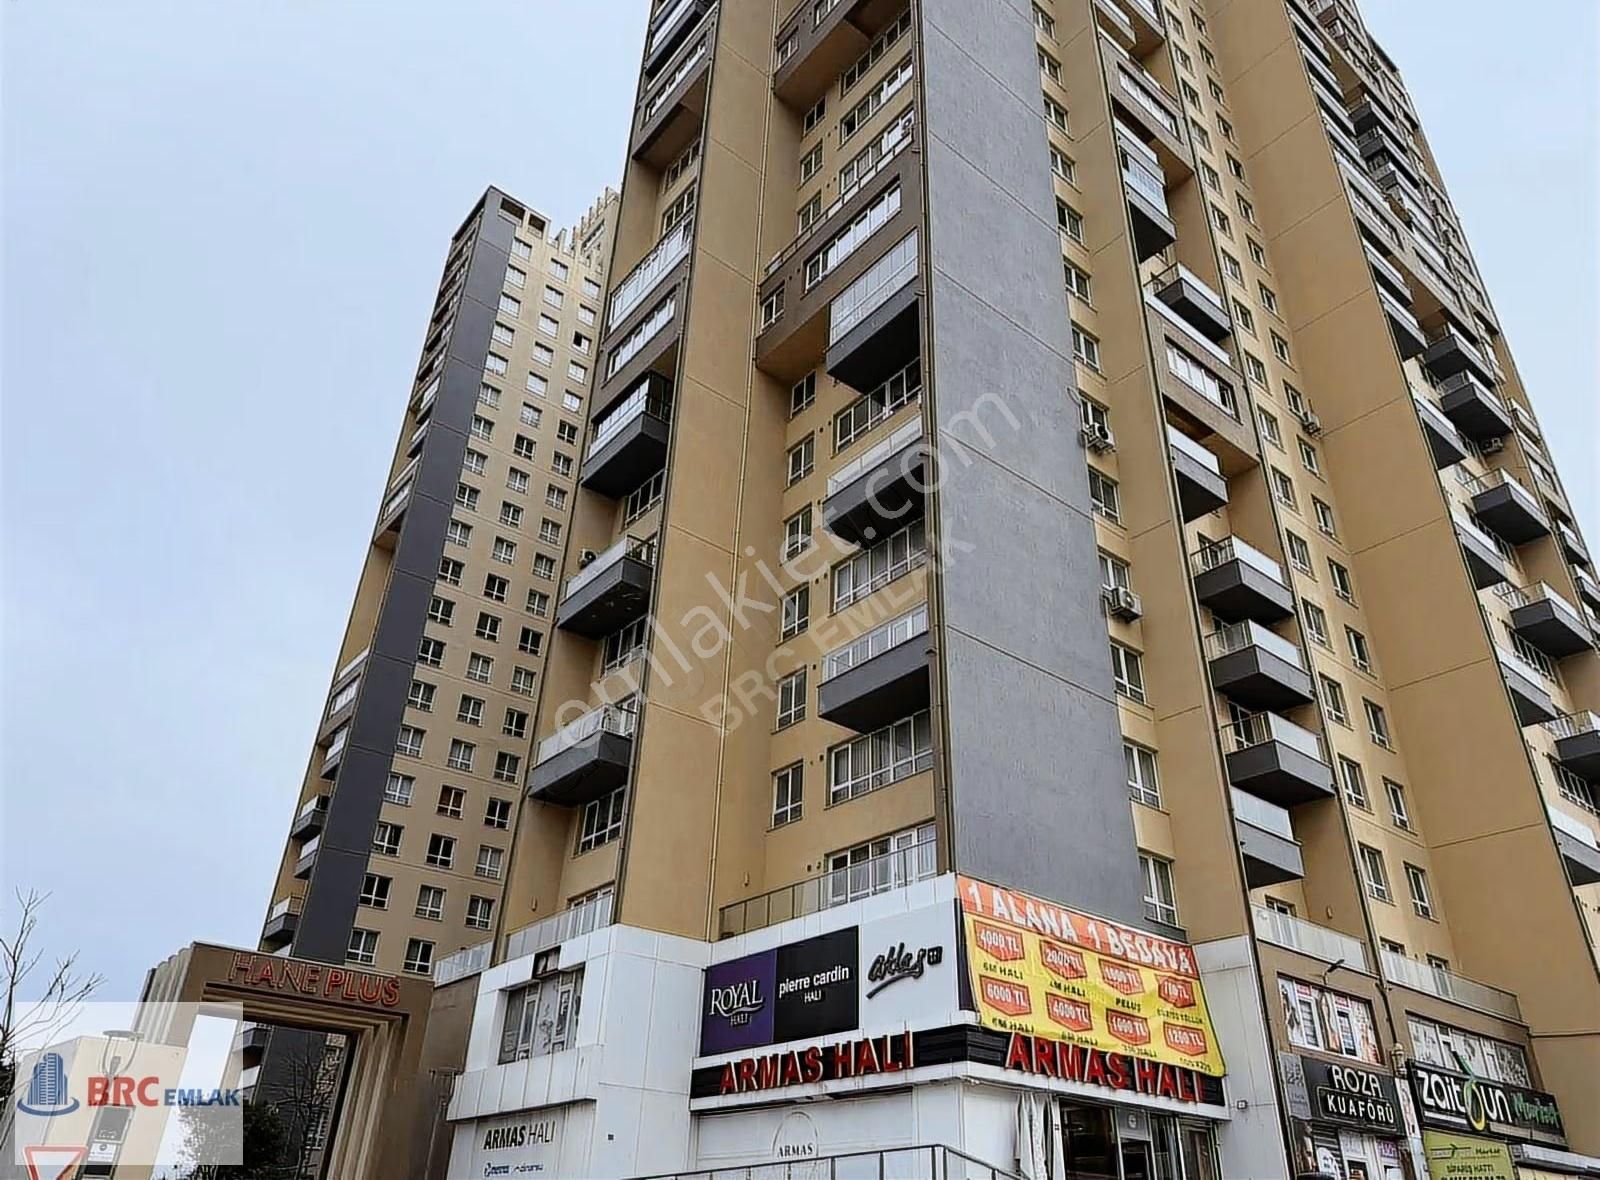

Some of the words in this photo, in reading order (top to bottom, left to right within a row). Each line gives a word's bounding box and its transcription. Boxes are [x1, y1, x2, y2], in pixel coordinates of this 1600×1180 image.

[967, 883, 984, 912] 1
[993, 889, 1079, 942] ALANA
[1087, 919, 1102, 950] 1
[1107, 921, 1194, 976] BEDAVA
[228, 951, 321, 993] HANE
[323, 968, 401, 1007] PLUS
[709, 979, 764, 1016] ROYAL
[779, 976, 811, 999] pierre
[813, 965, 849, 986] cardin
[720, 1046, 823, 1095] ARMAS
[834, 1030, 915, 1079] HALI
[1005, 1031, 1127, 1090] ARMAS
[1132, 1056, 1206, 1104] HALI
[1331, 1064, 1383, 1098] ROZA
[483, 1125, 527, 1150] ARMAS
[527, 1120, 557, 1145] HALI
[777, 1143, 814, 1157] ARMAS
